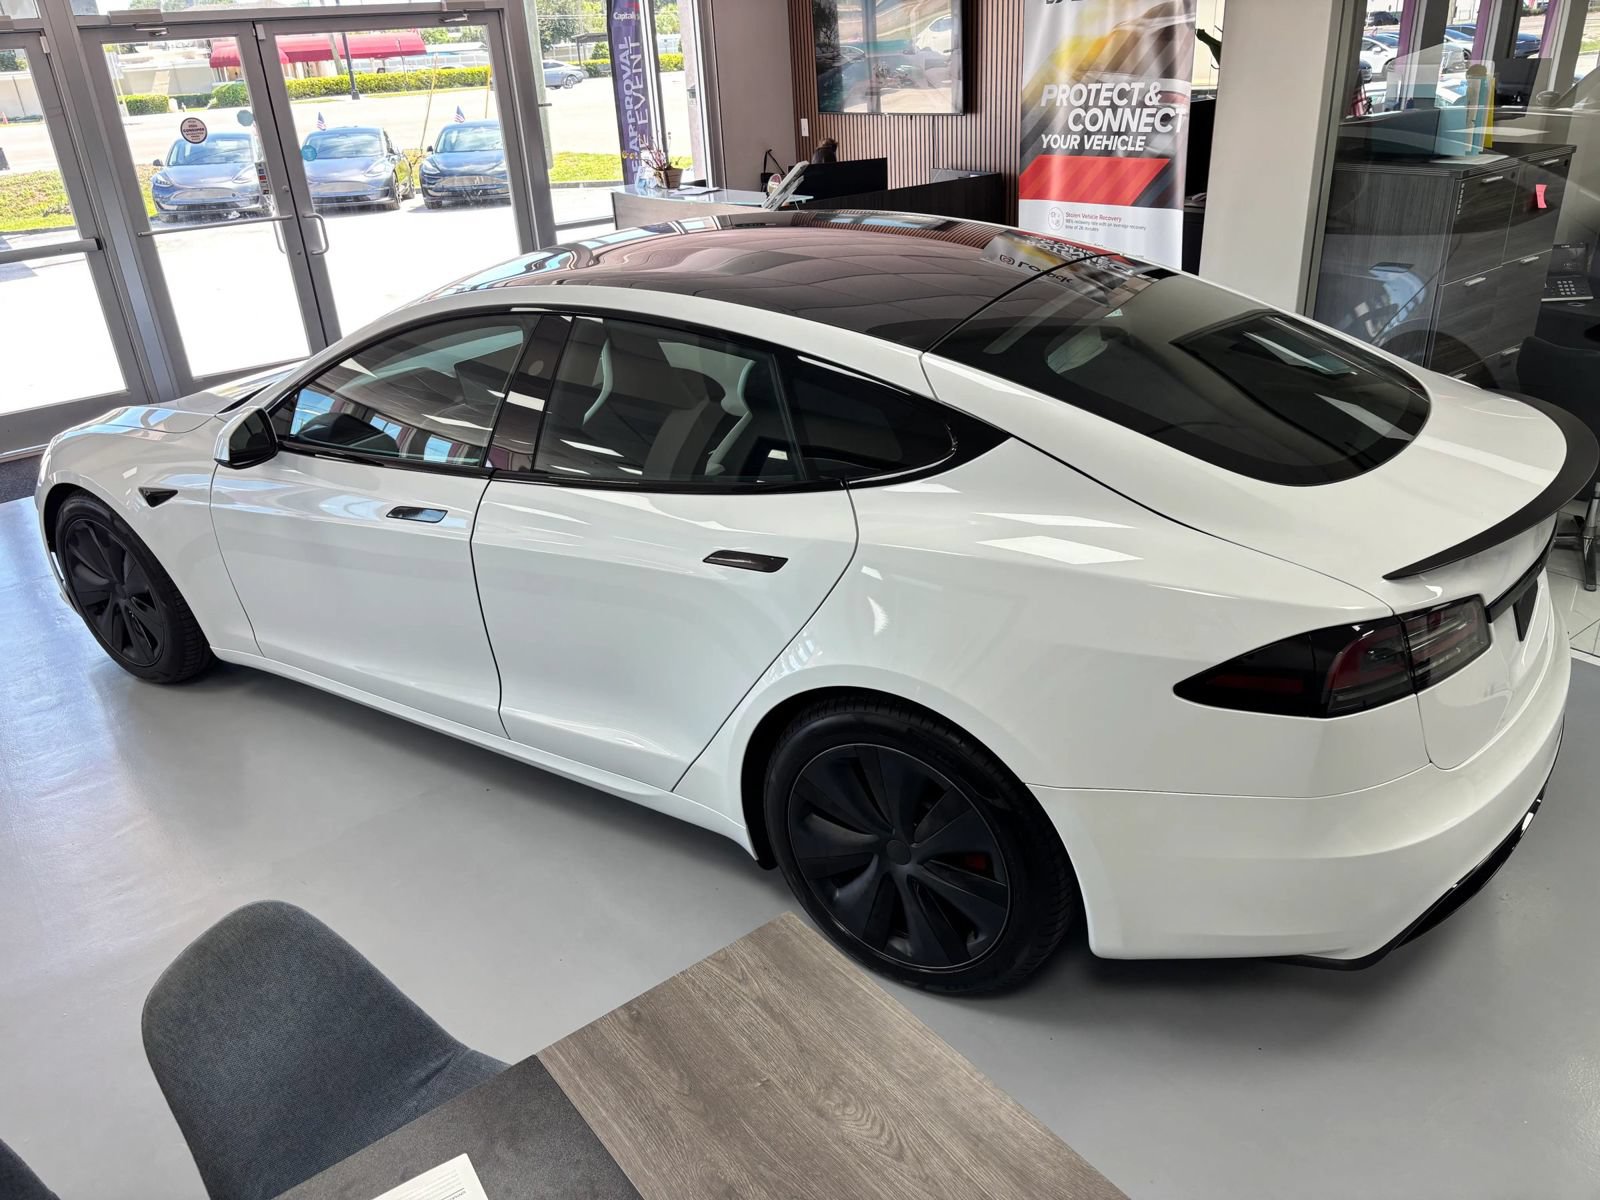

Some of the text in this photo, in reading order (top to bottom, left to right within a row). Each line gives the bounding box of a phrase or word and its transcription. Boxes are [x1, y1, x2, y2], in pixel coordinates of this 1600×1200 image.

[629, 40, 649, 125] EVENT
[1041, 82, 1162, 107] PROTECT &
[1068, 106, 1186, 133] CONNECT
[1041, 134, 1147, 152] YOUR VEHICLE
[1082, 212, 1098, 221] Vehicle
[1099, 214, 1122, 223] Recovery
